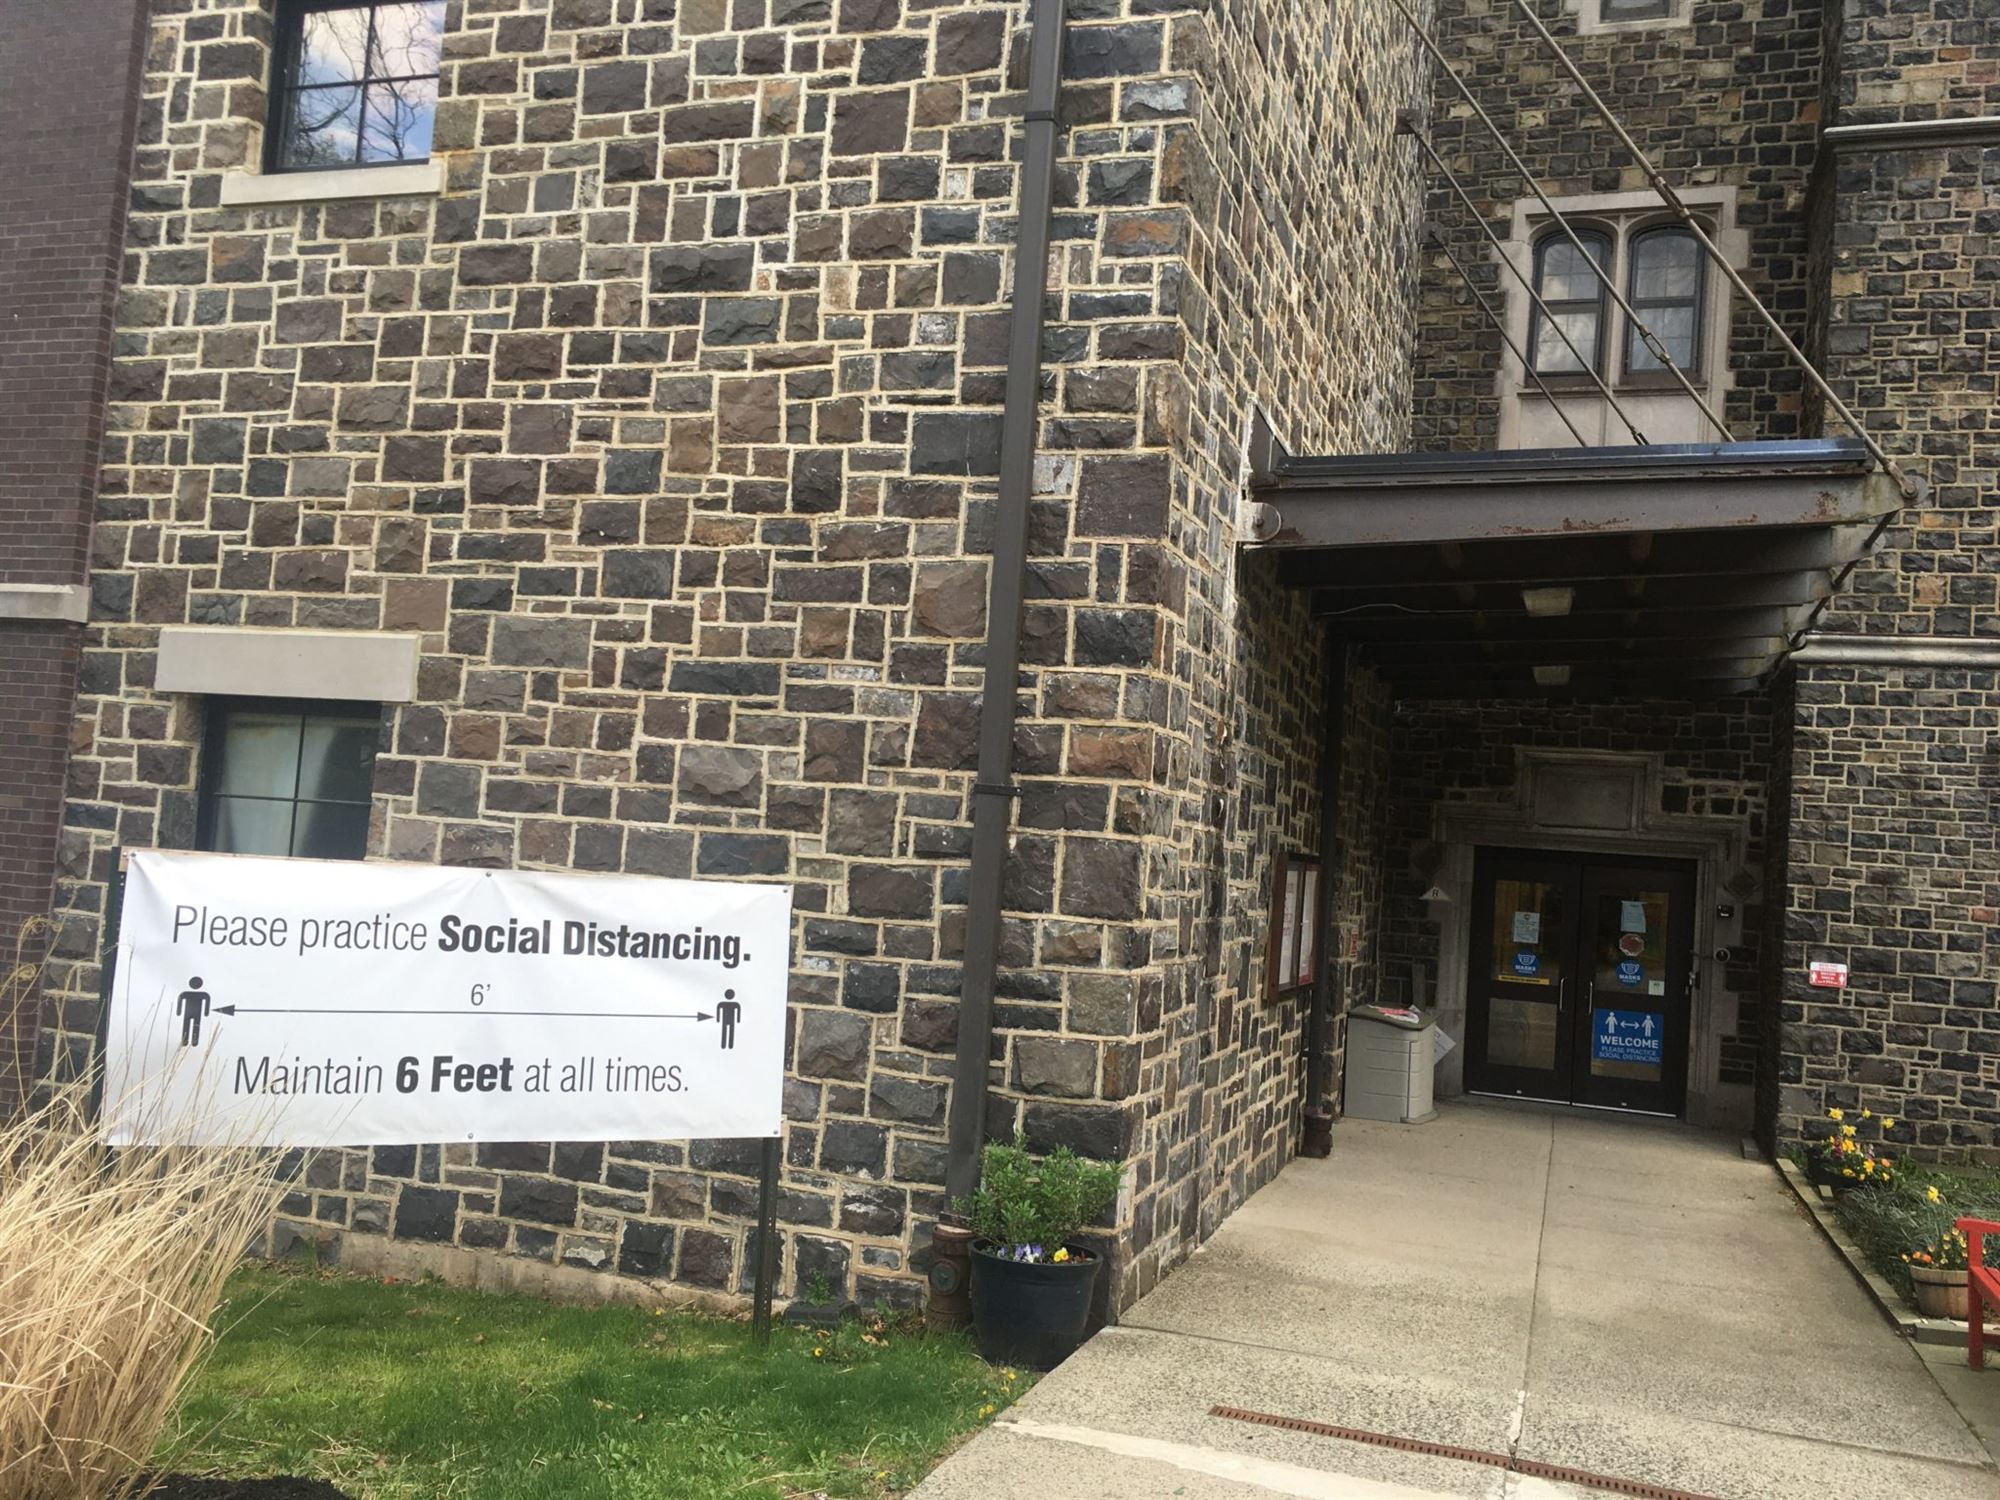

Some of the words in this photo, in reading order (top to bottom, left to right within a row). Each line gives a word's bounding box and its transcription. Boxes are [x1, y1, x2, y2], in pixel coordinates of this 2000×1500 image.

[173, 905, 288, 947] Please
[299, 913, 427, 956] practice
[438, 914, 551, 954] Social
[563, 919, 751, 969] Distancing.
[1600, 1035, 1659, 1049] WELCOME
[234, 1056, 383, 1095] Maintain
[395, 1056, 420, 1094] 6
[431, 1055, 514, 1093] Feet
[524, 1058, 552, 1093] at
[560, 1056, 594, 1093] all
[605, 1057, 688, 1092] times.
